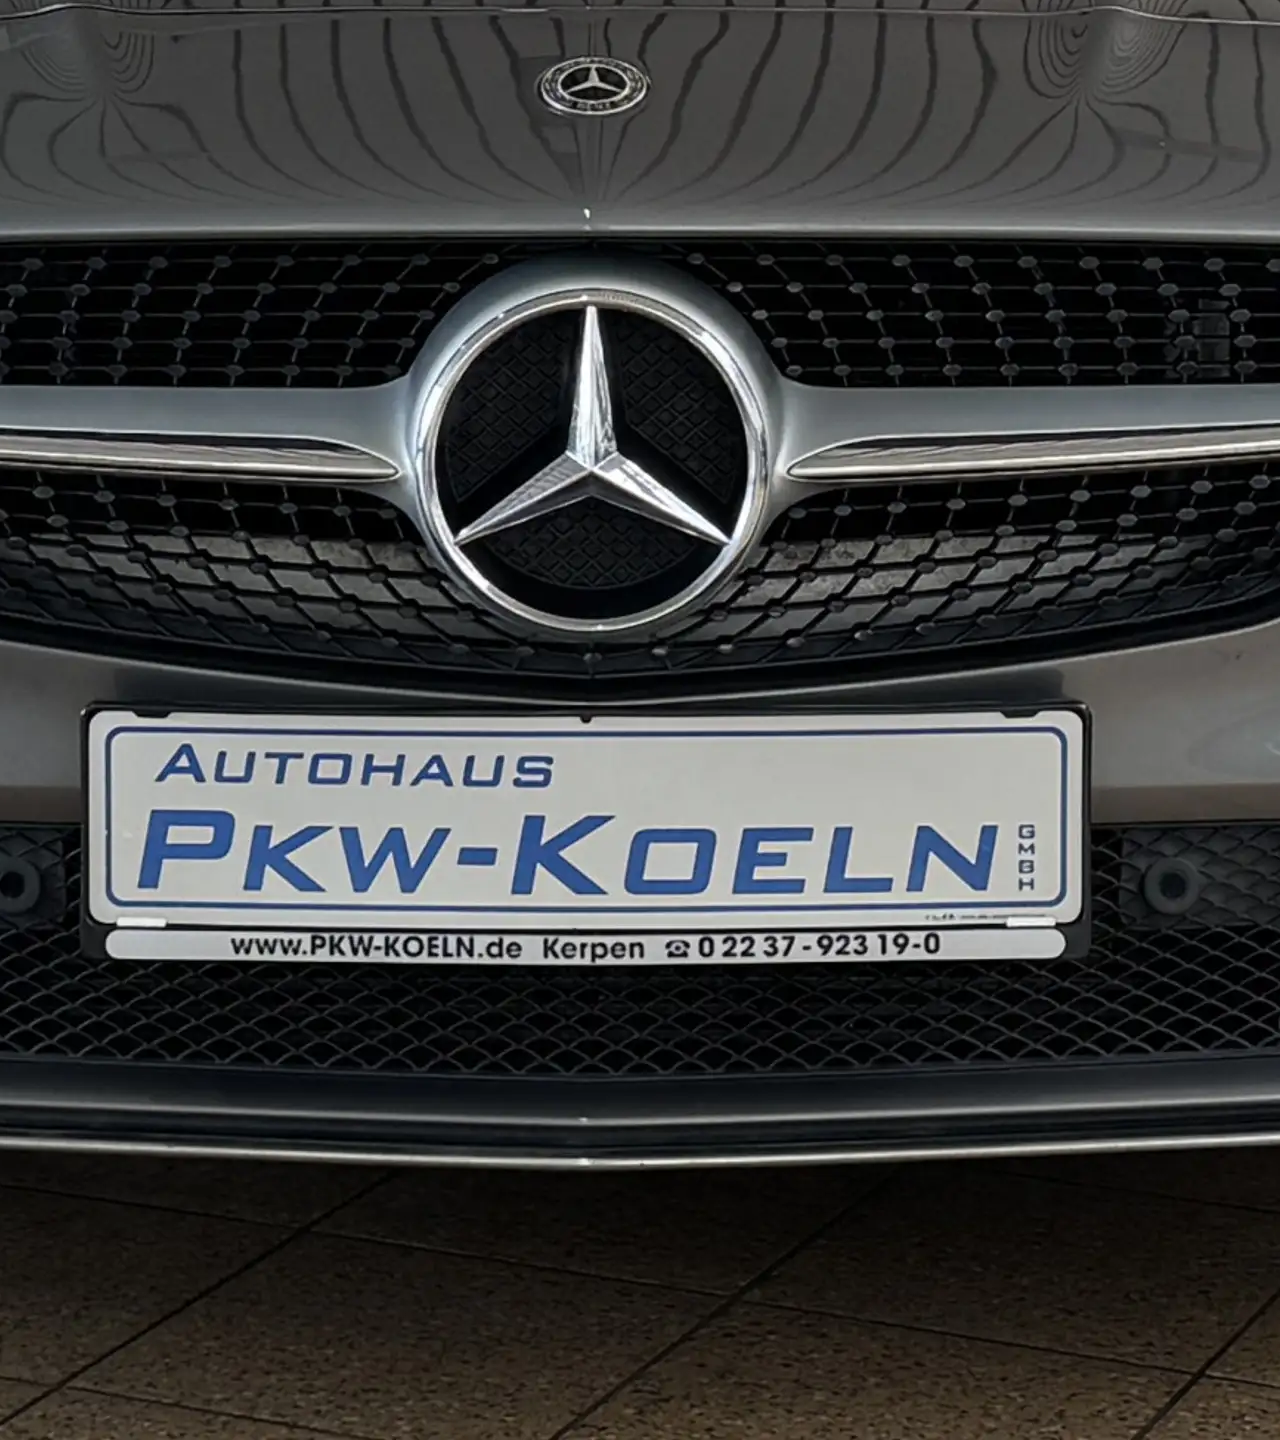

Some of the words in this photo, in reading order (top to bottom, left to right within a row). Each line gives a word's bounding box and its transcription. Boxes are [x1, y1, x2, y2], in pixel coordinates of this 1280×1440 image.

[155, 742, 555, 789] AUTOHAUS
[137, 808, 999, 895] PKW-KOELN
[1018, 823, 1036, 892] GMBH
[230, 934, 523, 960] www.PKW-KOELN.de
[542, 937, 646, 963] Kerpen
